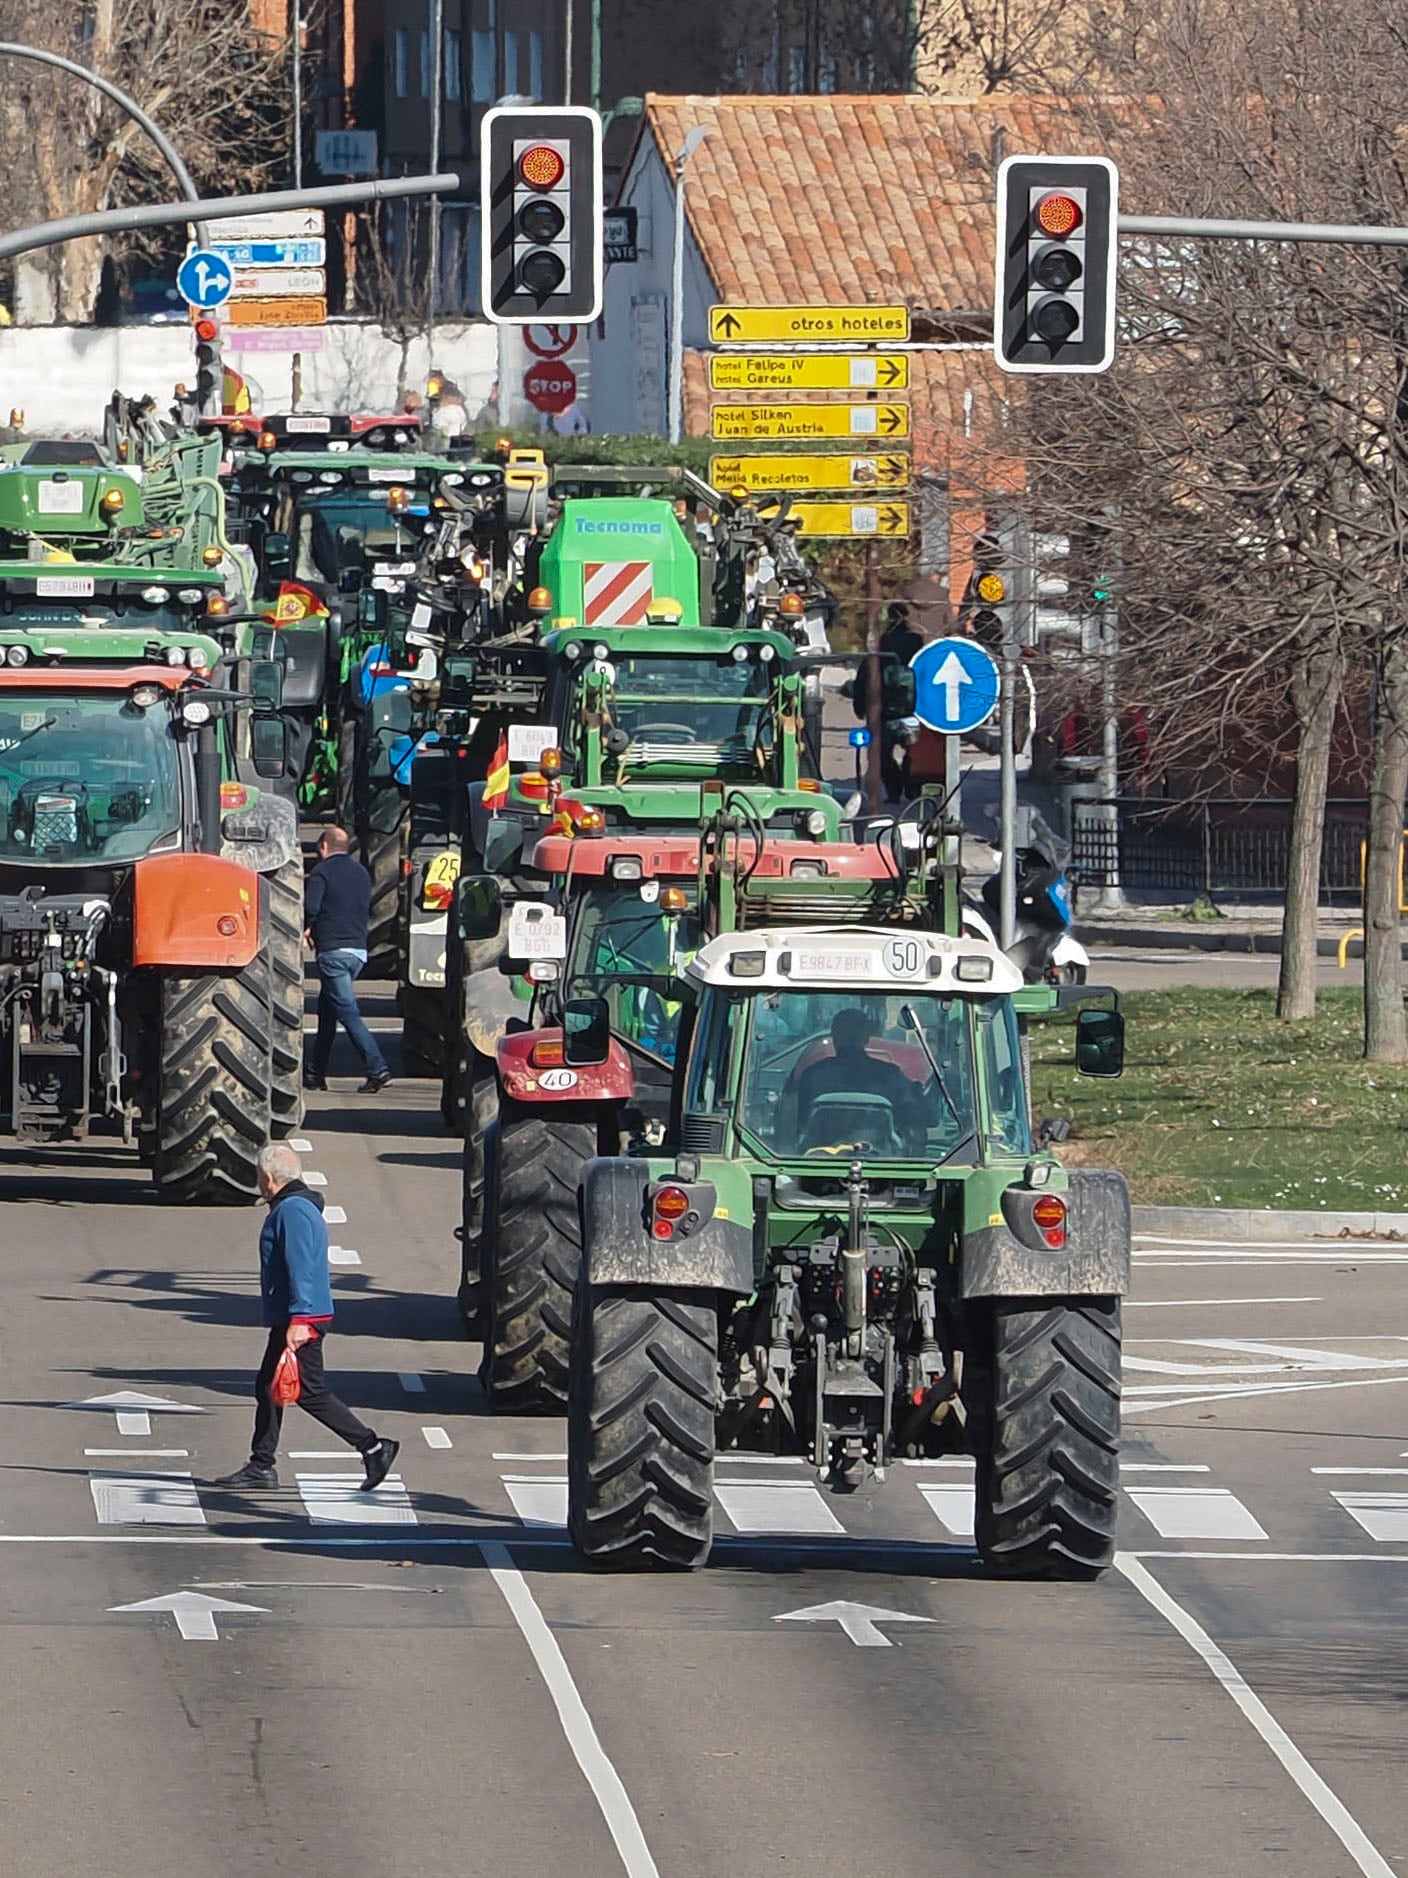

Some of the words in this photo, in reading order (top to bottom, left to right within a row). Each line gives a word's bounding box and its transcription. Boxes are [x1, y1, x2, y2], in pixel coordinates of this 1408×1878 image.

[791, 317, 834, 331] otros
[842, 317, 903, 330] hoteles
[716, 361, 742, 370] hotel
[746, 359, 786, 373] Felipe
[792, 359, 805, 370] IV
[747, 373, 793, 384] Gareus
[529, 379, 572, 395] STOP
[716, 411, 745, 421] hotel
[751, 409, 793, 421] Silken
[718, 423, 749, 434] Juan
[753, 424, 770, 435] de
[777, 422, 824, 434] Austria
[575, 517, 662, 534] Tecnoma
[437, 857, 459, 882] 25
[892, 941, 918, 972] 50
[543, 1072, 572, 1087] 40
